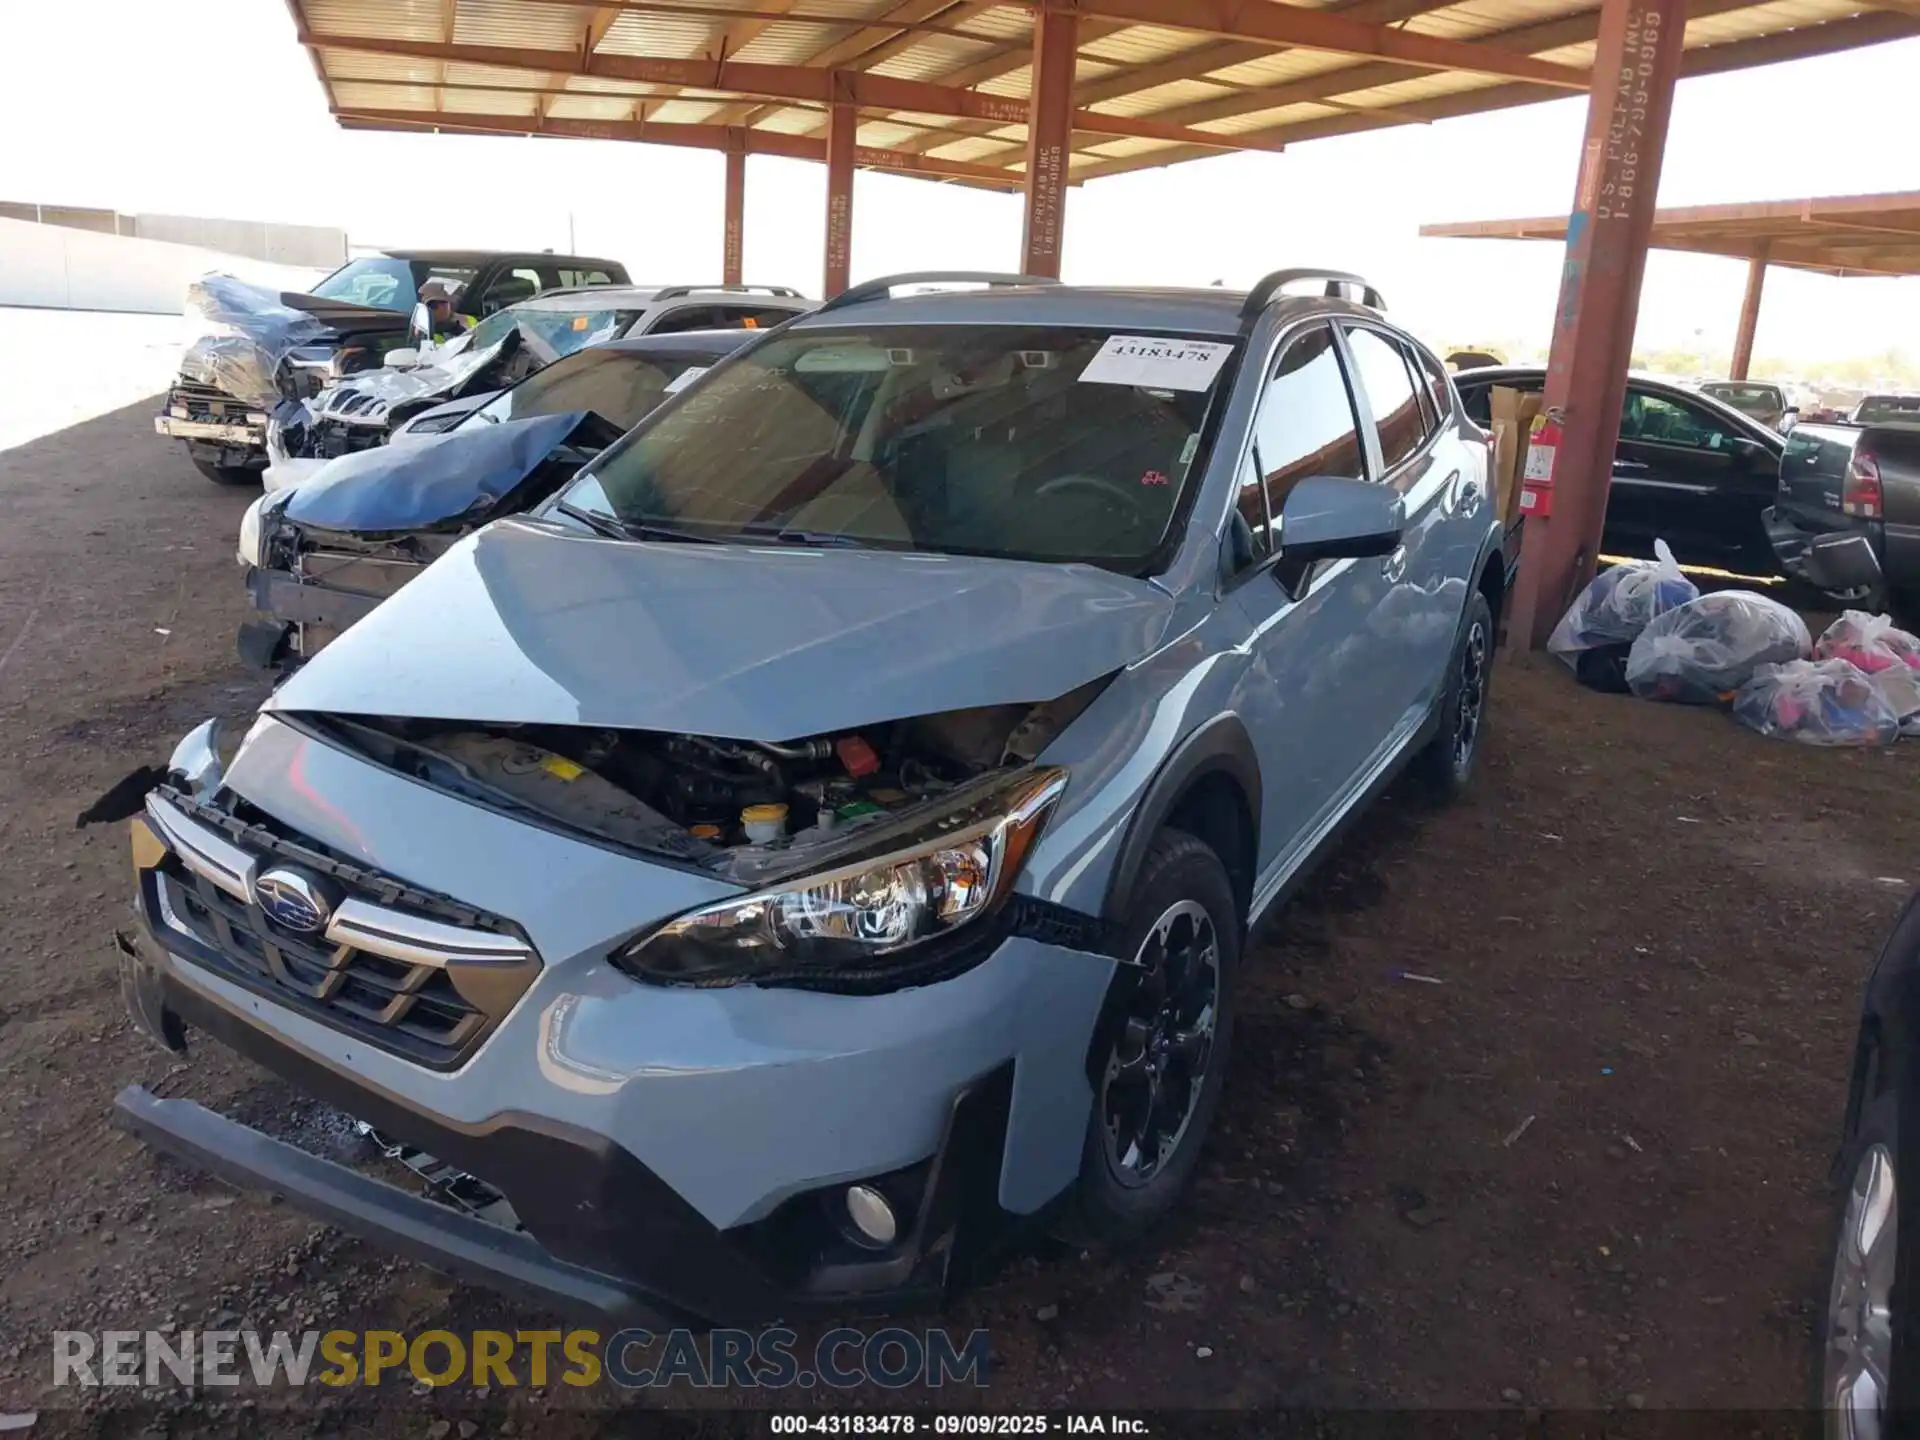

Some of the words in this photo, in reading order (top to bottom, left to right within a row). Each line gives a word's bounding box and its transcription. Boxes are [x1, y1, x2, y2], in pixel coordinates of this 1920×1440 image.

[1607, 67, 1635, 160] PREFAB
[1624, 7, 1644, 53] INC.
[1111, 345, 1211, 361] 43183478
